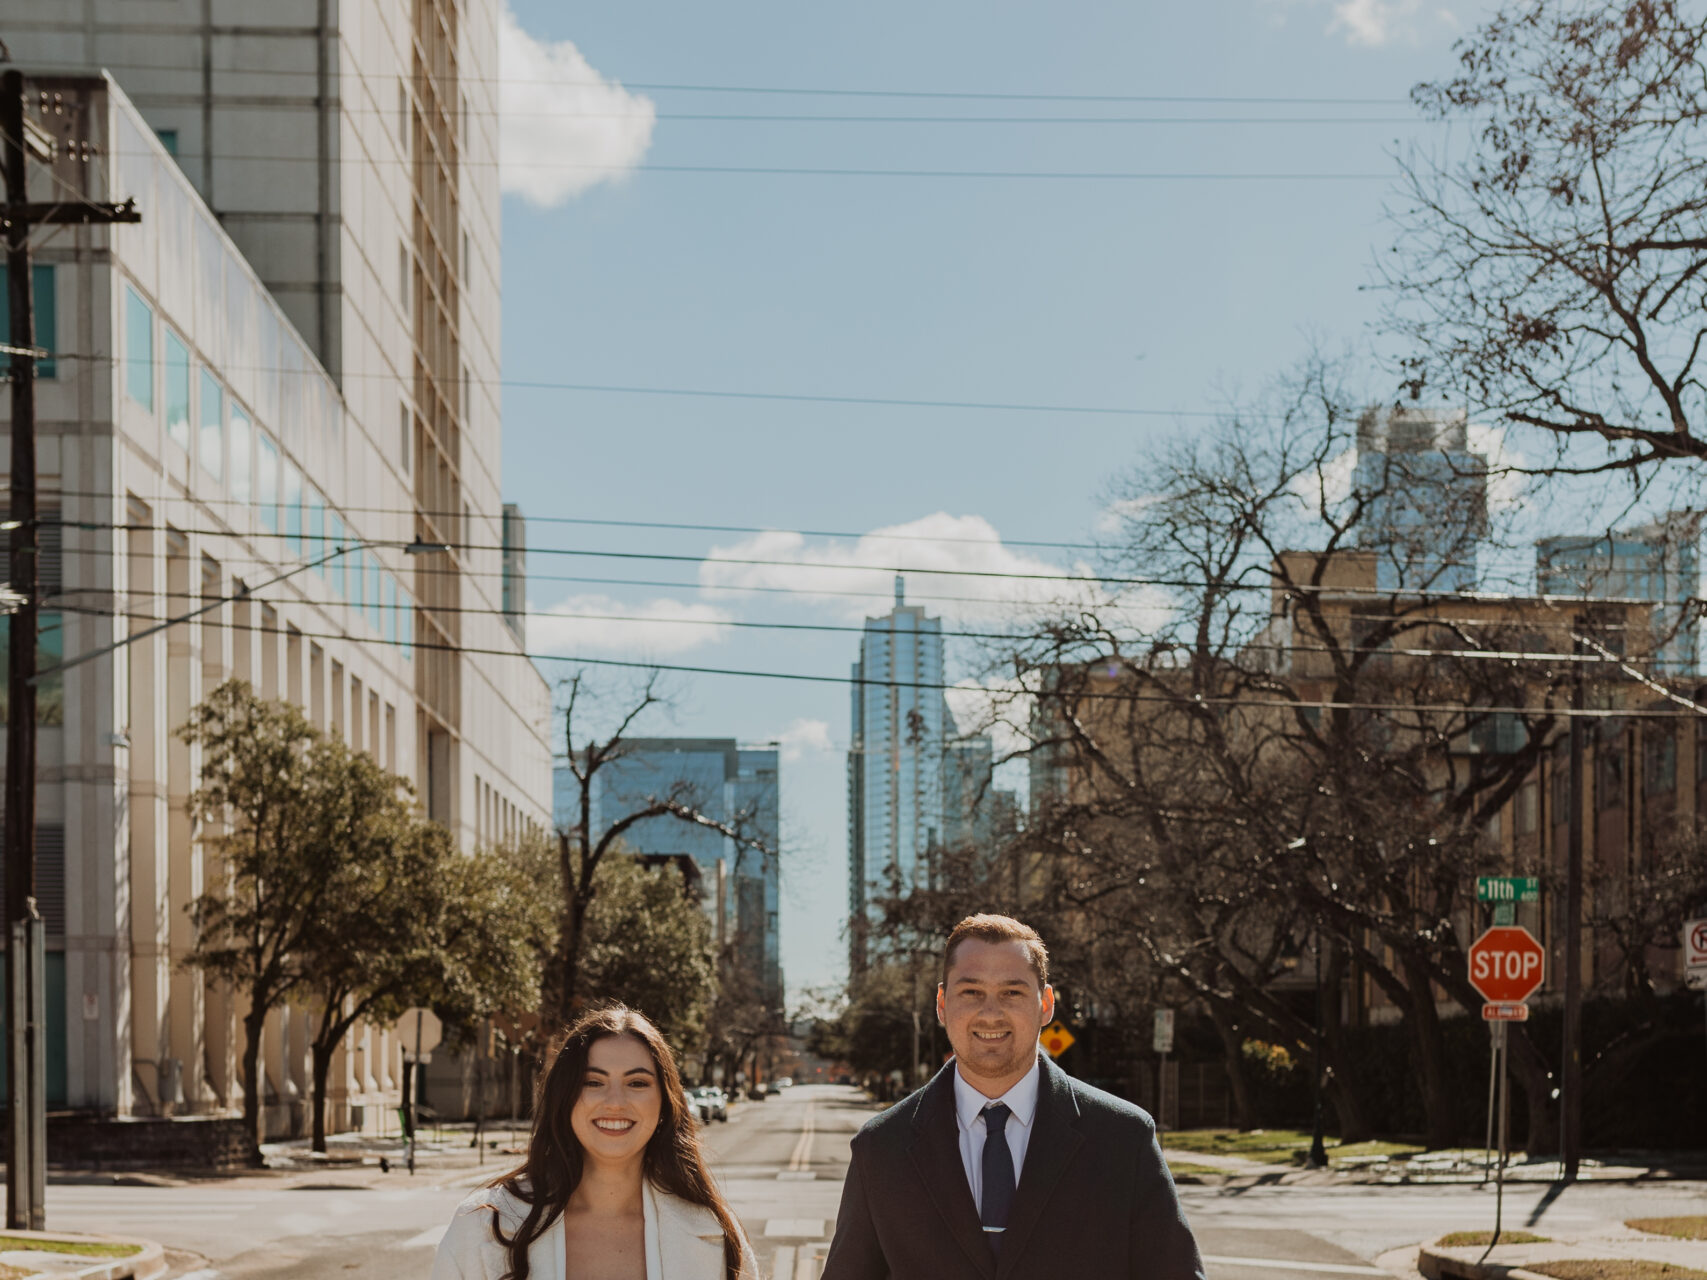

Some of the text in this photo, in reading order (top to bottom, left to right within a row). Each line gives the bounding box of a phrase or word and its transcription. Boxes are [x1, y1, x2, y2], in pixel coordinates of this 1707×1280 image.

[1488, 880, 1514, 899] 11th
[1527, 878, 1538, 888] ST
[1474, 951, 1539, 979] STOP
